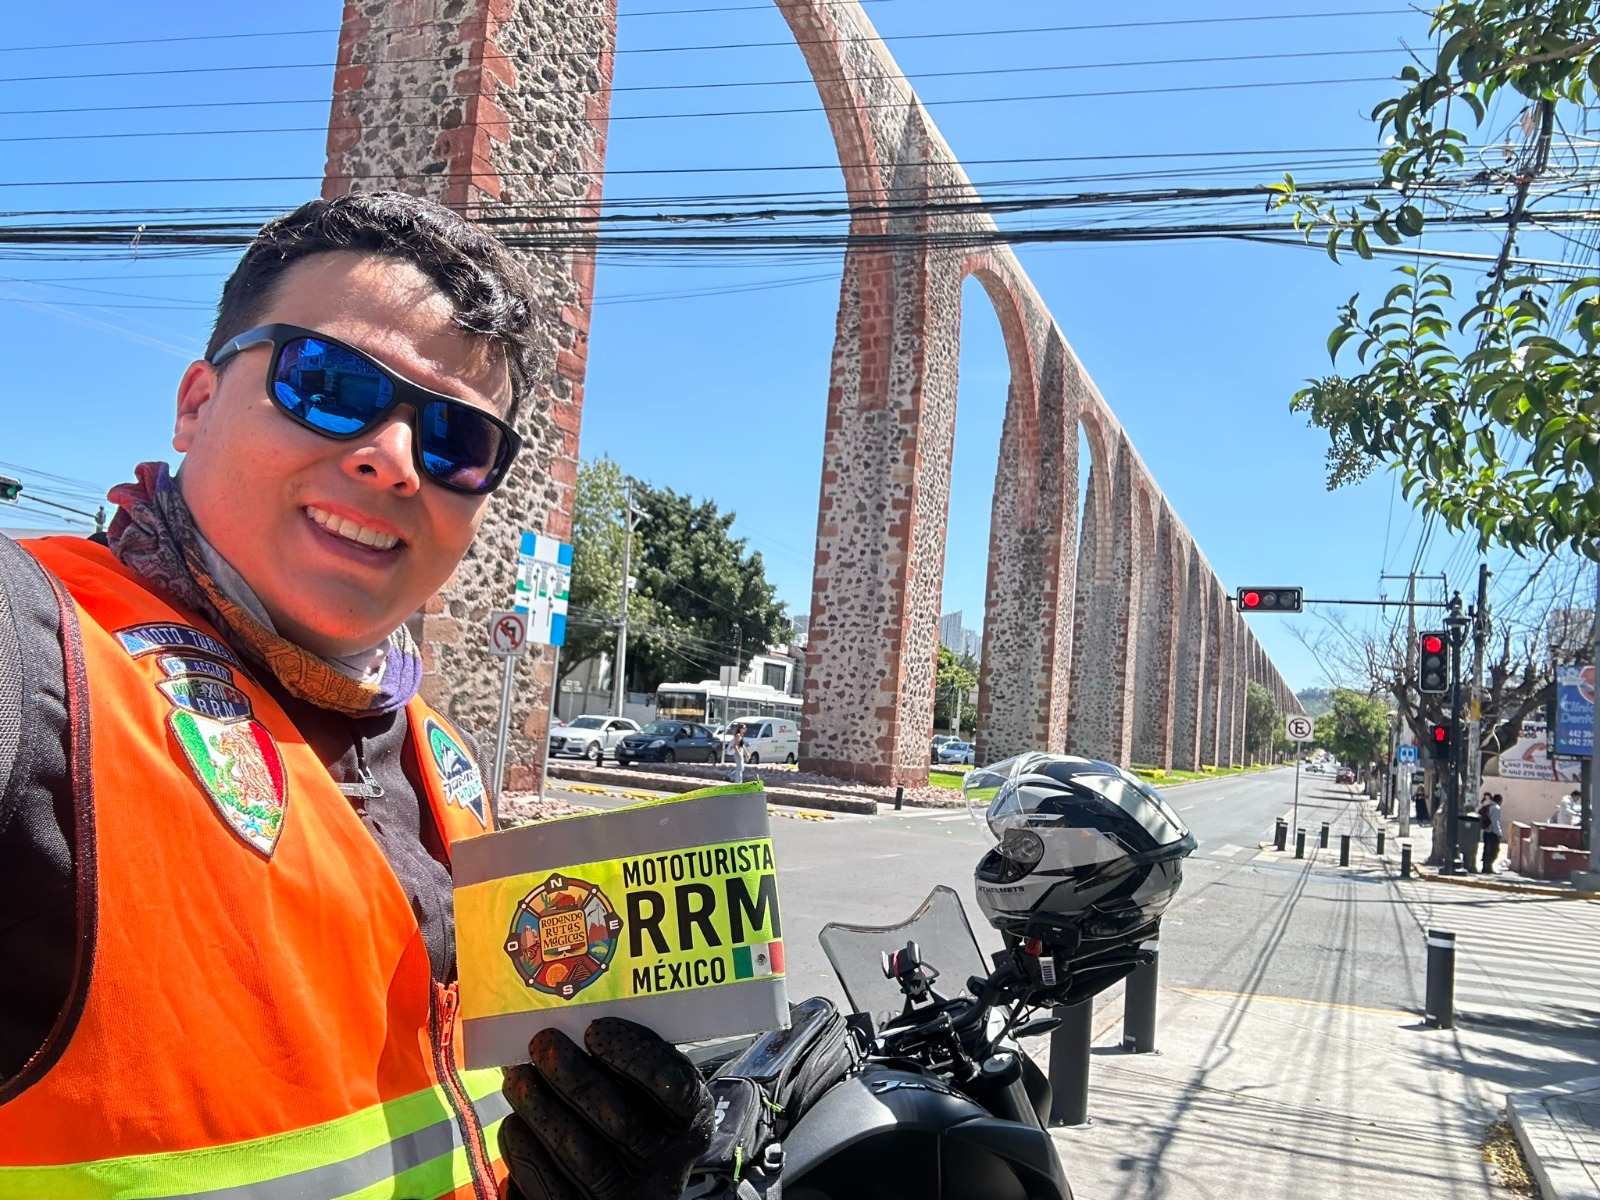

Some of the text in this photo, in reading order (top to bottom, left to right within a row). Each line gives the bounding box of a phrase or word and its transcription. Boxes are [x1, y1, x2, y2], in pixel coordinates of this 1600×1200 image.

[133, 628, 183, 646] MOTO
[197, 698, 237, 718] RRM
[622, 843, 774, 888] MOTOTURISTA
[550, 878, 563, 889] N
[609, 919, 620, 930] E
[626, 874, 782, 958] RRM
[507, 941, 519, 951] O
[632, 956, 726, 994] MÉXICO
[562, 984, 574, 995] S
